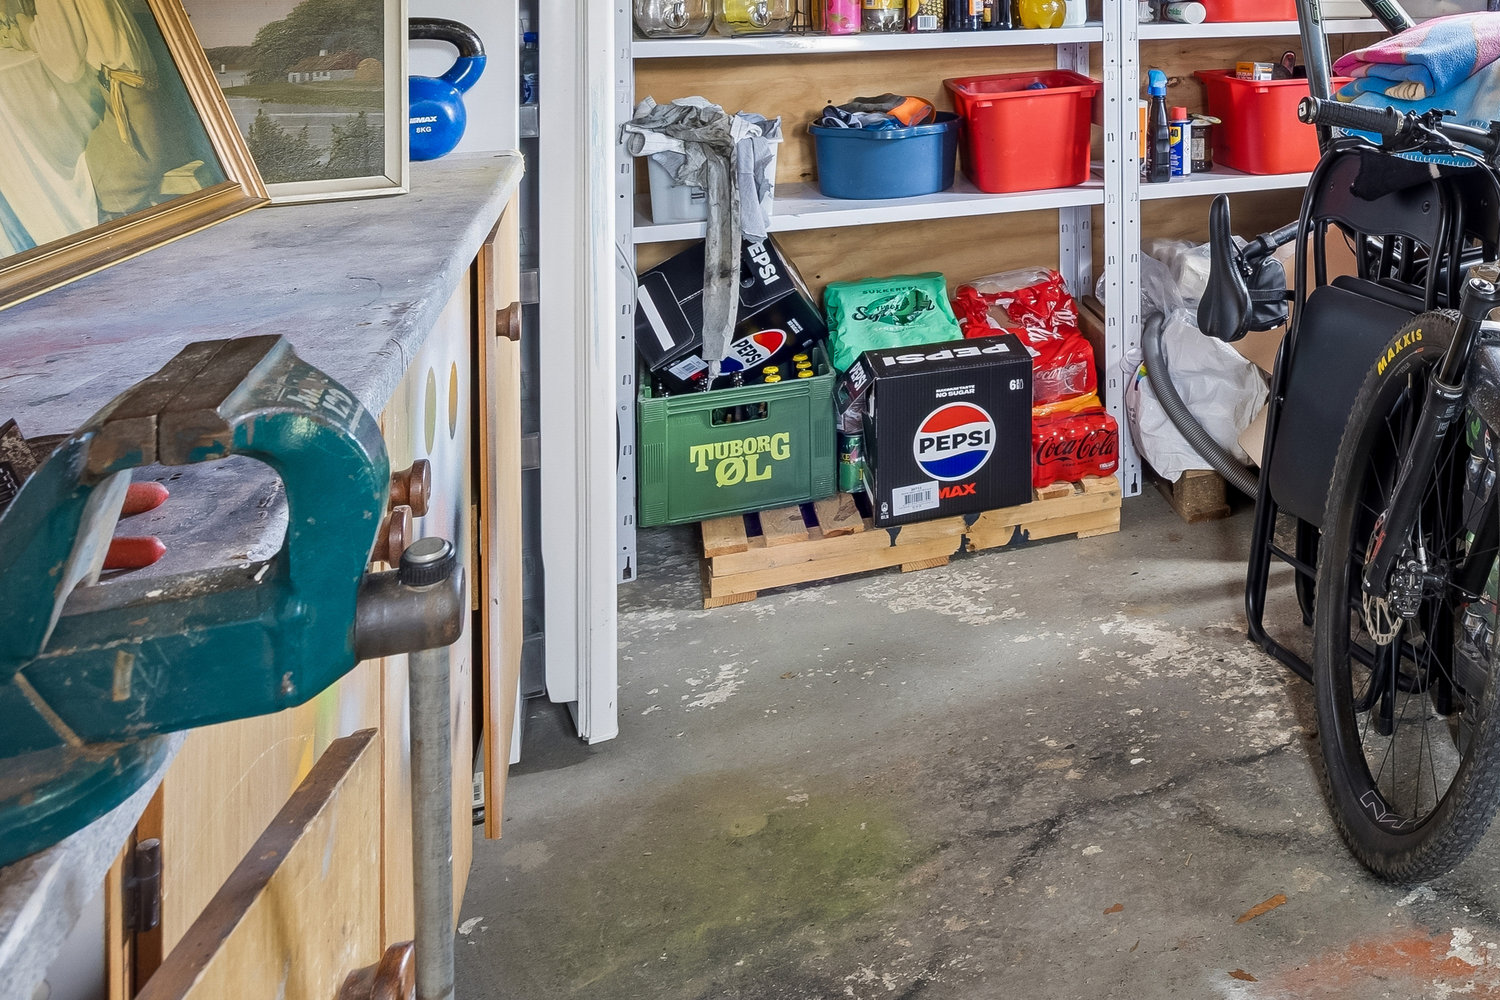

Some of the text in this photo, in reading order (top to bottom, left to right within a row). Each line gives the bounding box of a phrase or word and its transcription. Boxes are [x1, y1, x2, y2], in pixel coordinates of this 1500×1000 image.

[416, 126, 432, 134] 8KG
[747, 243, 781, 286] EPSI
[733, 339, 765, 367] PEPSI
[882, 343, 1011, 367] PEPSI
[1377, 328, 1423, 375] MAXXIS
[849, 361, 868, 391] PEPSI
[948, 388, 976, 397] SUGAR
[690, 432, 790, 472] TUBORG
[919, 428, 990, 454] PEPSI
[715, 453, 772, 487] ØL
[939, 482, 976, 499] MAX
